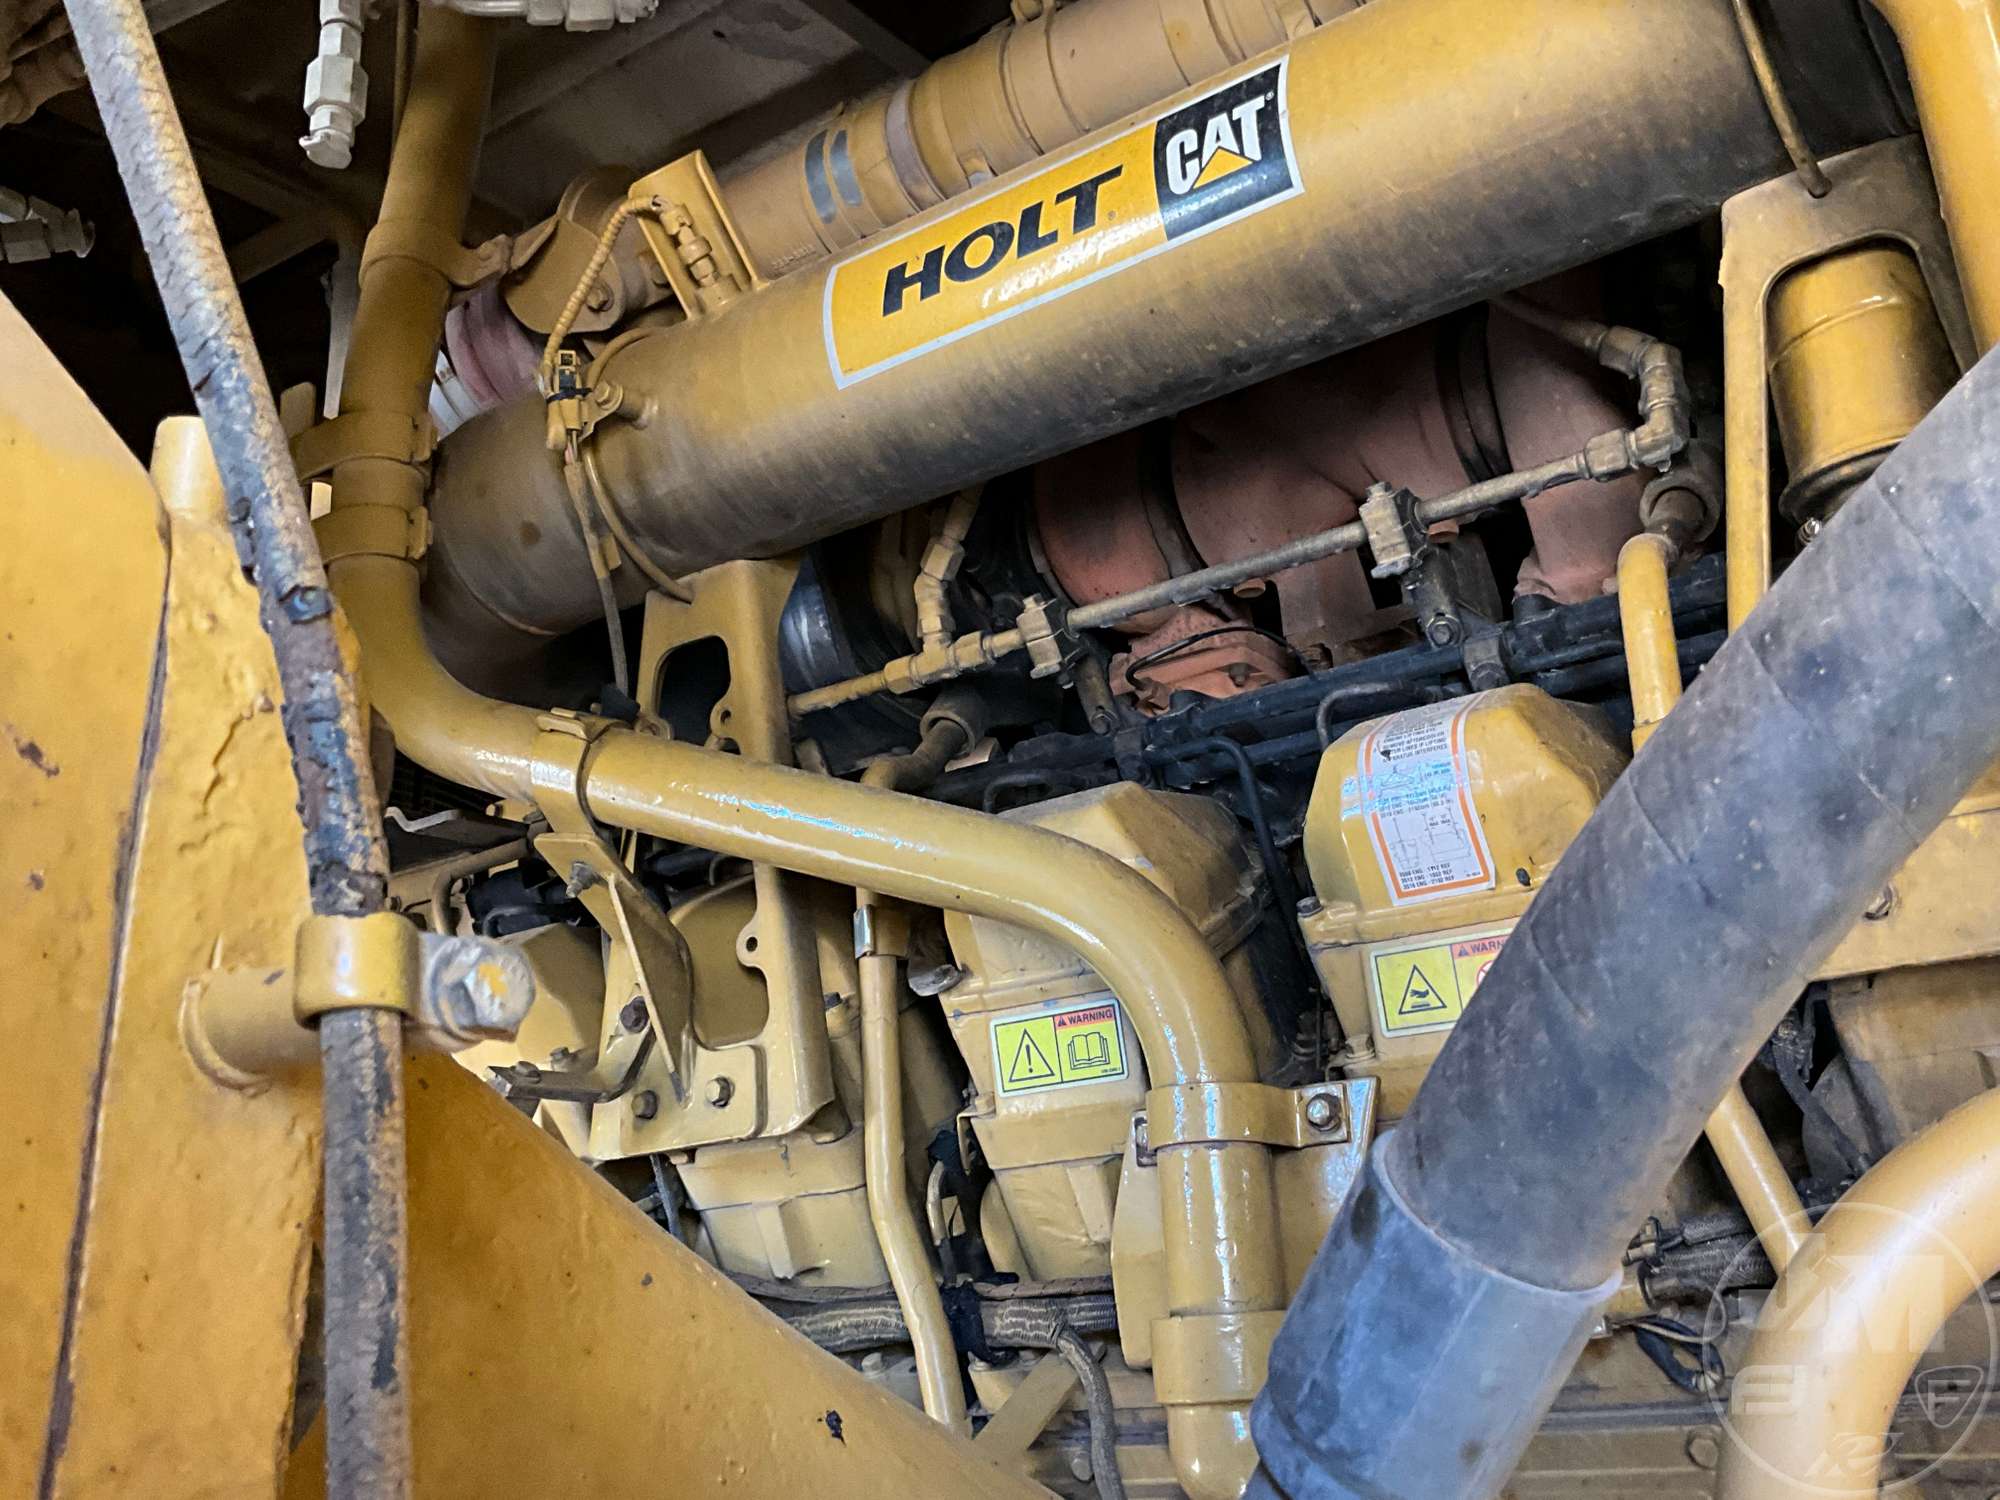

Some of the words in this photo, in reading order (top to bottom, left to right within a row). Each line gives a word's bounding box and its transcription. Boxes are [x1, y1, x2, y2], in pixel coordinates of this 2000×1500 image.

[882, 164, 1124, 317] HOLT
[1165, 94, 1265, 196] CAT
[1471, 939, 1505, 954] WARN
[1068, 1009, 1112, 1025] WARNING
